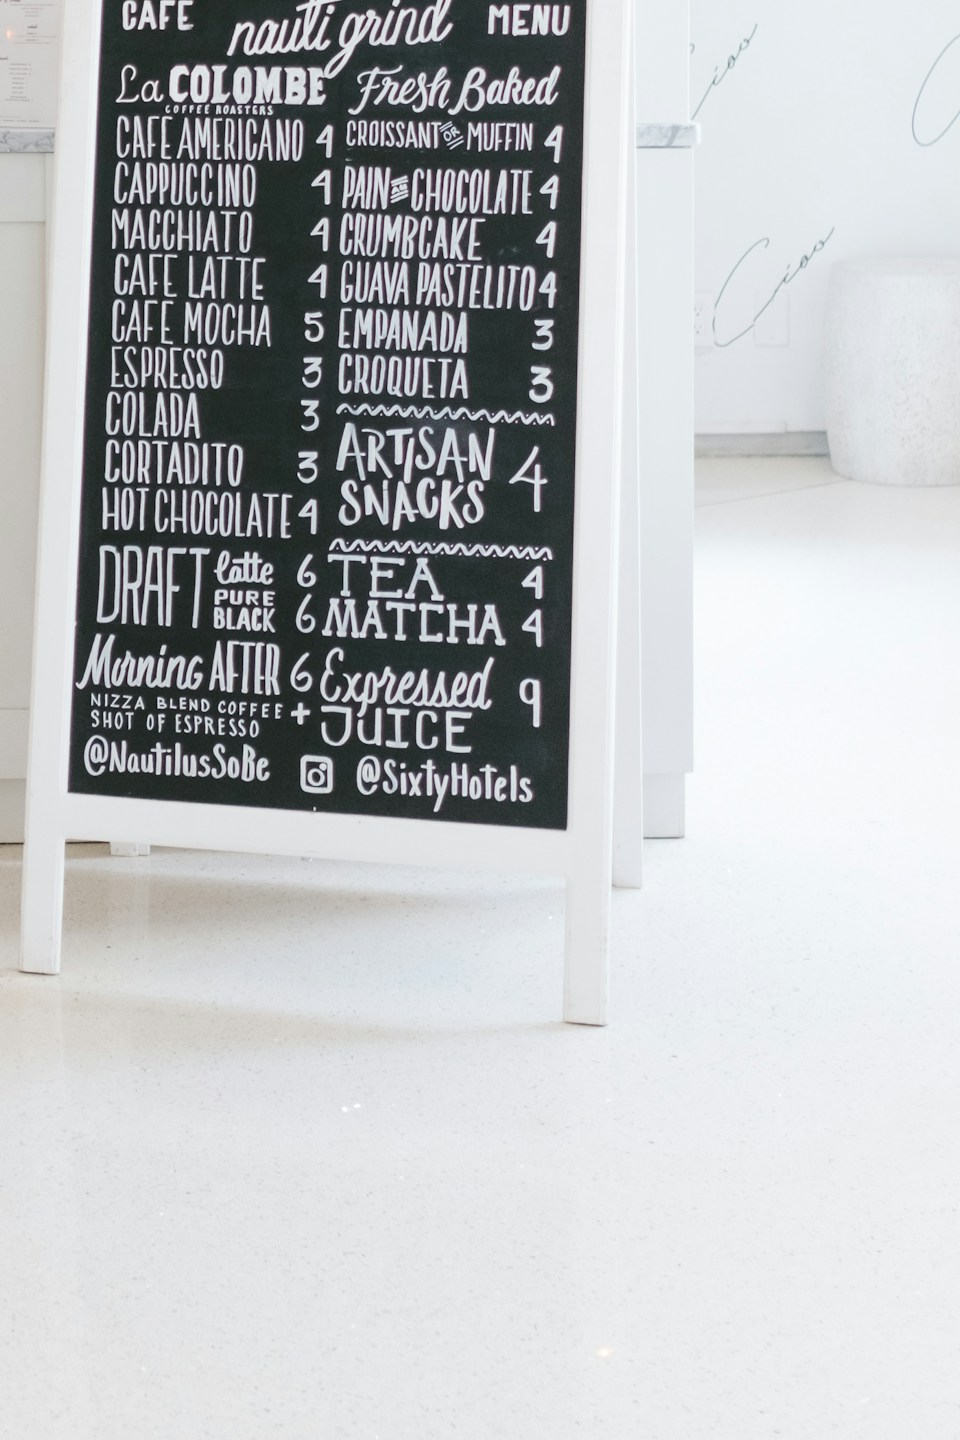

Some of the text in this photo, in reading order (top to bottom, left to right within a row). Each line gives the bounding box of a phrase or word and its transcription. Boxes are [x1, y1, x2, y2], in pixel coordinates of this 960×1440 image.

[122, 0, 194, 30] CAFE
[488, 4, 570, 36] MENU
[116, 64, 327, 106] La COLOMBE
[348, 65, 561, 115] Fresh Baked
[165, 104, 273, 115] COFFEE ROASTERS
[117, 115, 333, 161] CAFE AMERICANO 4
[346, 120, 563, 163] CROISSANT OR MUFFIN 4
[114, 161, 331, 207] CAPPUCCINO 4
[342, 166, 391, 210] PAIN
[411, 168, 533, 215] CHOCOLATE
[539, 175, 559, 209] 4
[112, 208, 329, 253] MACCHIATO 4
[340, 213, 557, 261] CRUMBCAKE 4
[114, 254, 327, 300] CAFE LATTE 4
[341, 260, 557, 311] GUAVA PASTELITO 4
[713, 227, 835, 348] Ciao
[112, 299, 324, 347] CAFE MOCHA 5
[338, 308, 554, 353] EMPANADA 3
[111, 346, 322, 389] ESPRESSO 3
[338, 353, 553, 403] CROQUETA 3
[105, 391, 319, 439] COLADA 3
[105, 439, 318, 486] CORTADITO 3
[336, 422, 495, 484] ARTISAN
[509, 446, 548, 512] 4
[102, 487, 317, 538] HOT CHOCOLATE 4
[339, 477, 484, 531] SNACKS
[97, 545, 316, 628] DRAFT latte 6
[214, 589, 275, 606] PURE
[328, 554, 543, 601] TEA 4
[214, 594, 315, 633] BLACK 6
[322, 598, 542, 647] MATCHA 4
[75, 633, 313, 695] Morning AFTER 6
[320, 647, 541, 727] Expressed 9
[91, 693, 144, 710] NIZZA
[157, 697, 210, 712] BLEND
[218, 701, 283, 719] COFFEE
[91, 710, 259, 737] SHOT OF ESPRESSO
[321, 705, 472, 753] JUICE
[84, 735, 270, 782] @NautilusSoBe
[357, 755, 533, 812] @SixtyHotels
